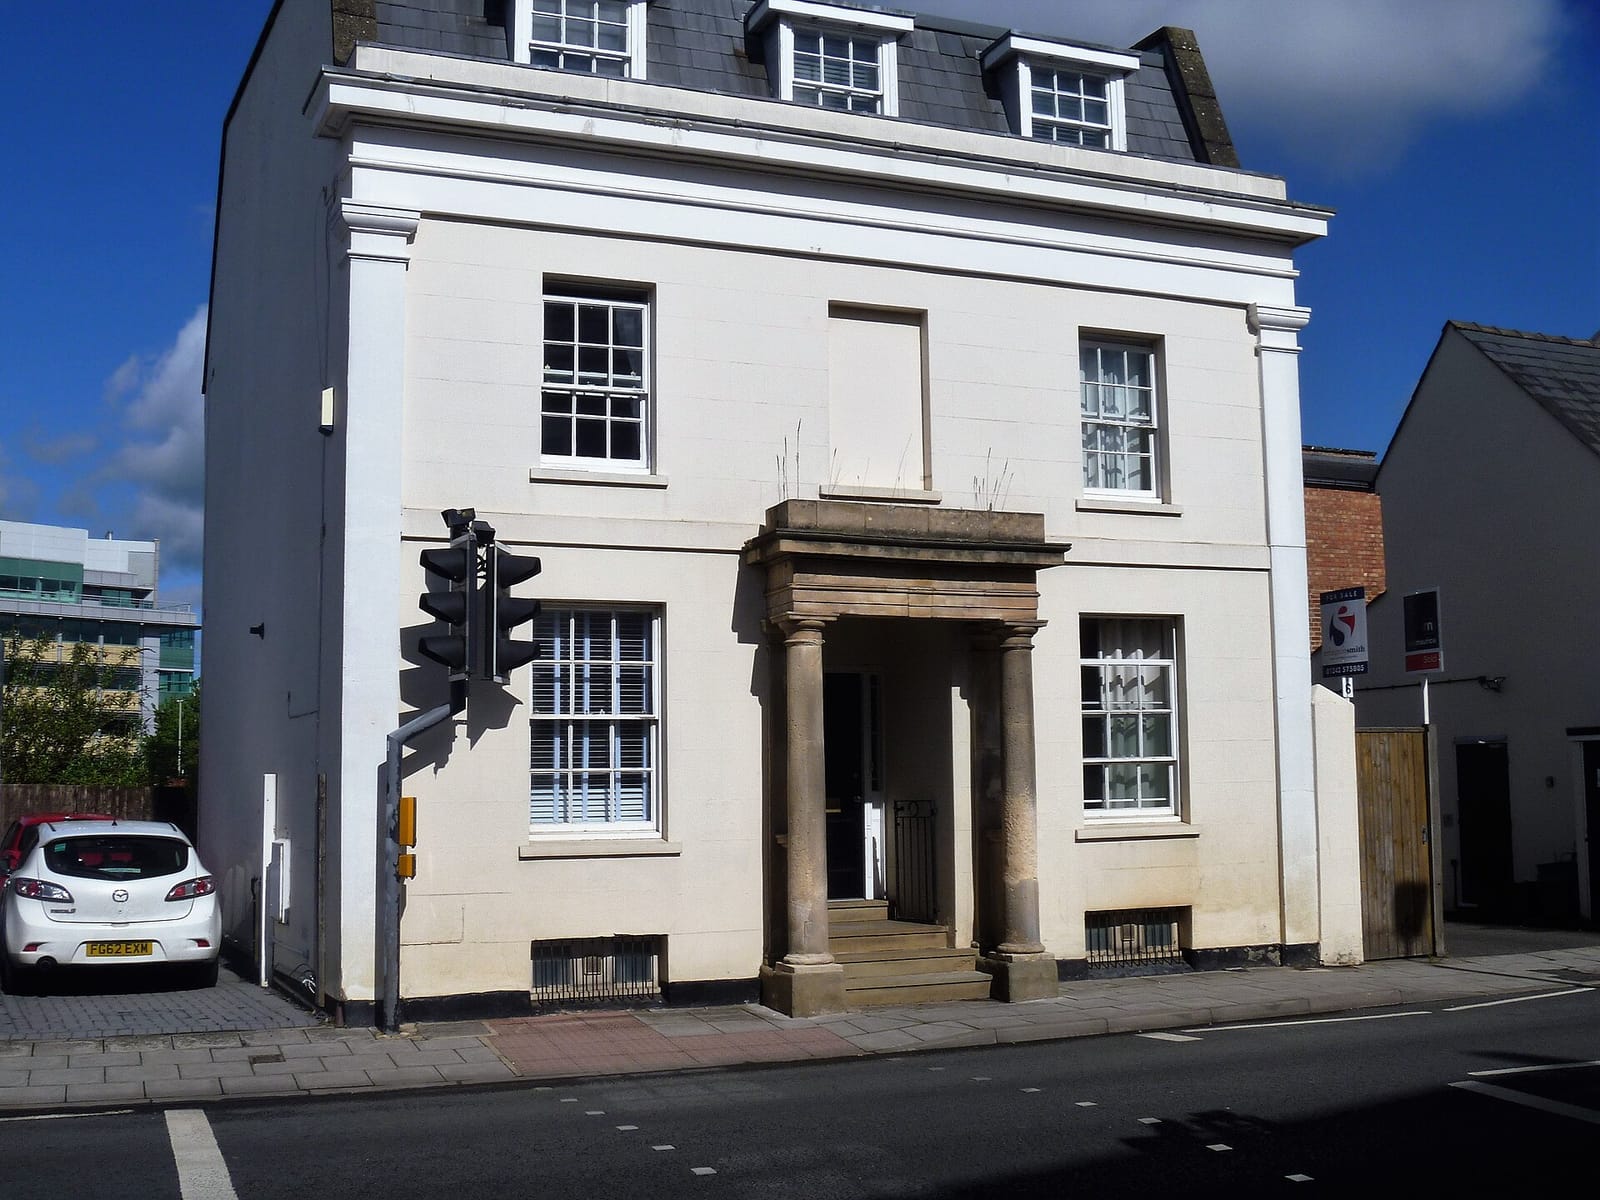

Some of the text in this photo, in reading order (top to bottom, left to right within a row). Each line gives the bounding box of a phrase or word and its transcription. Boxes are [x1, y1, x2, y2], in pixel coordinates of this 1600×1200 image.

[1340, 590, 1358, 598] SALE
[1346, 645, 1365, 653] smith
[90, 942, 148, 954] FG62 EXM
